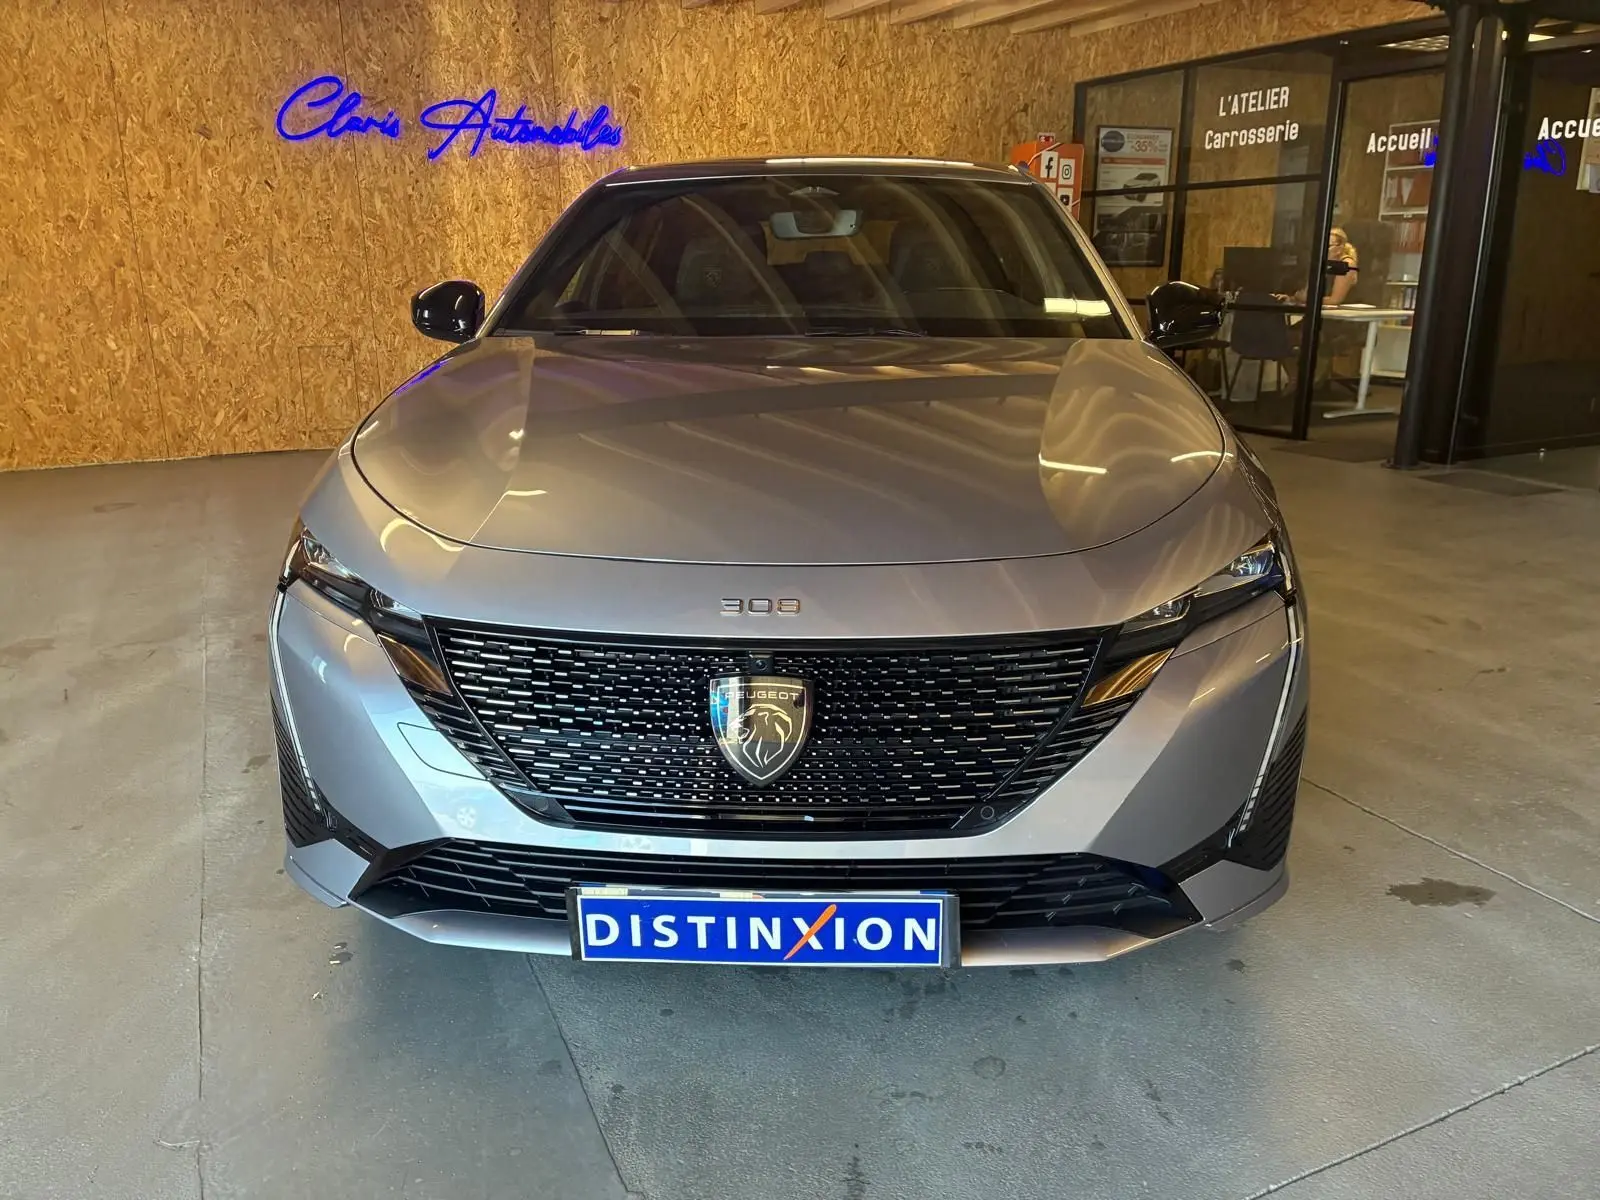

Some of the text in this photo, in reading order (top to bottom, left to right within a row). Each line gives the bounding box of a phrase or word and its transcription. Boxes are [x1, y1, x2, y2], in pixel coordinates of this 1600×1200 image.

[1218, 86, 1290, 117] L'ATELIER
[419, 89, 623, 160] Automobiles
[1204, 119, 1300, 150] Carrosserie
[1366, 127, 1432, 154] Accueil
[719, 598, 801, 617] 308
[725, 691, 799, 700] PEUGEOT
[585, 904, 937, 960] DISTINXION
